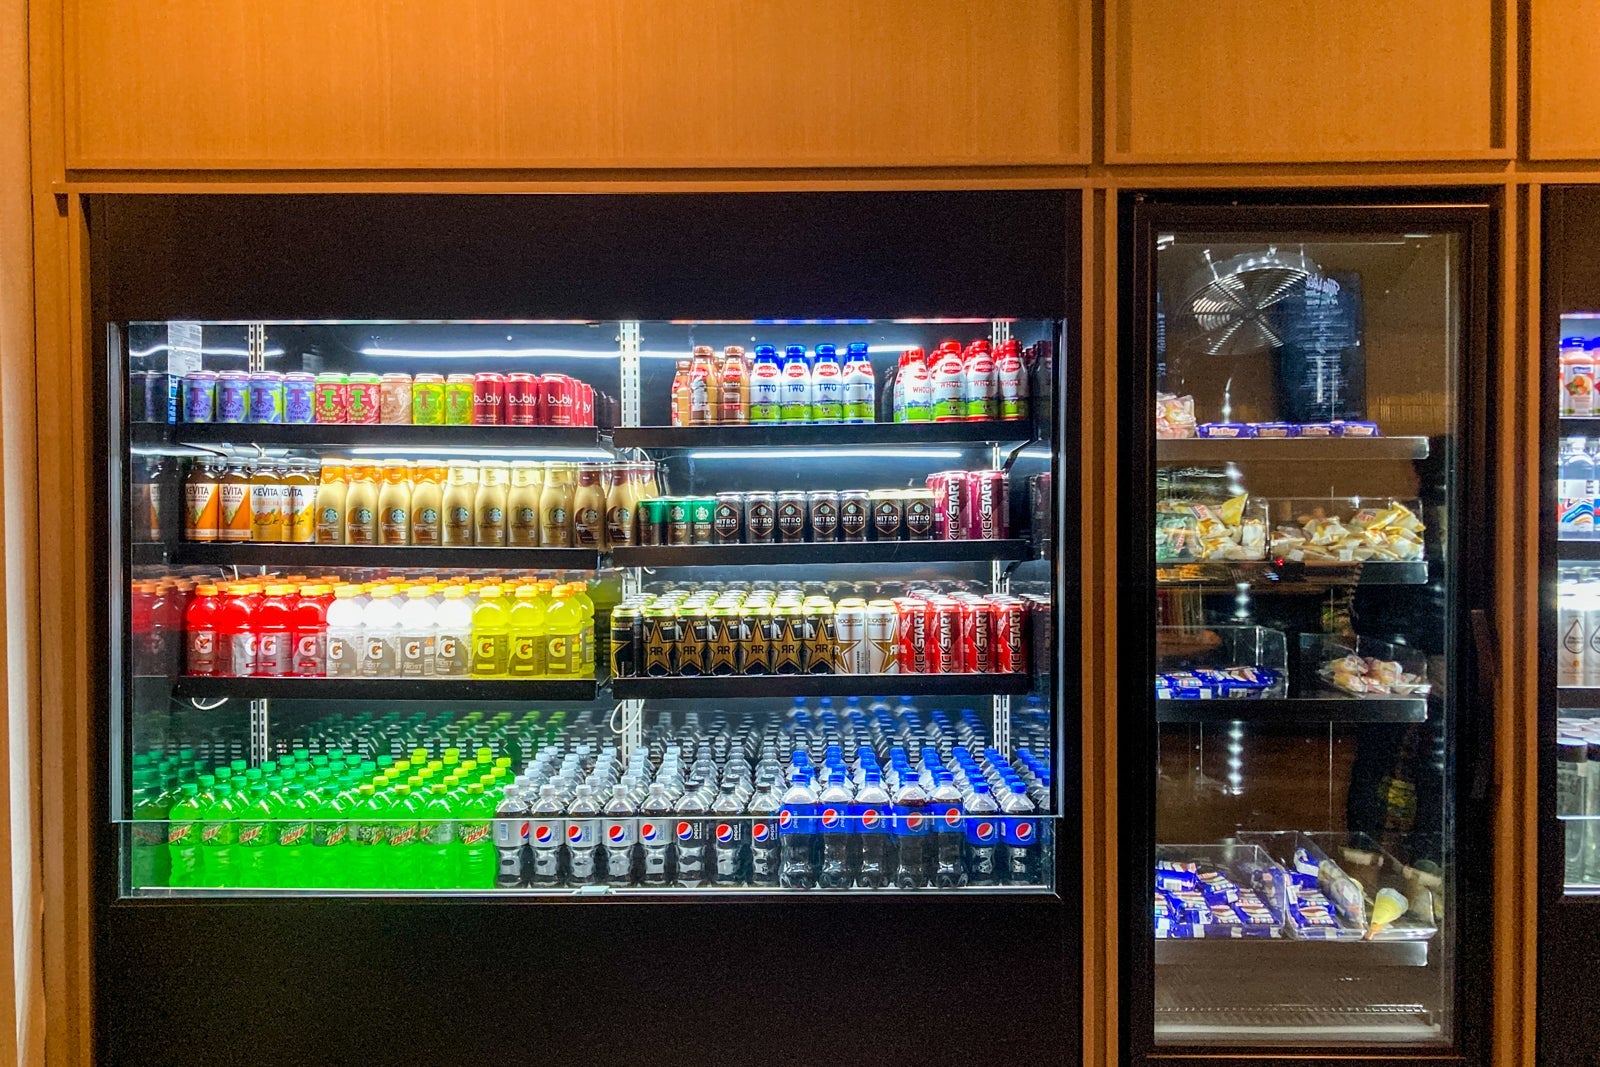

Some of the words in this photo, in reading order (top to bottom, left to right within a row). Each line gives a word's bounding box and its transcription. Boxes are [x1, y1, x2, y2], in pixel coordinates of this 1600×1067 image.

[758, 384, 777, 393] TWO
[788, 384, 805, 393] TWO
[819, 383, 837, 392] TWO
[473, 393, 501, 406] bubly
[509, 393, 537, 406] bubly
[222, 486, 243, 496] EVITA
[253, 487, 278, 497] KEVITA
[780, 517, 801, 525] NITRO
[260, 636, 276, 656] G
[299, 636, 316, 656] G
[329, 641, 342, 660] G
[368, 641, 382, 660] G
[405, 641, 420, 659] G
[440, 639, 455, 658] G
[477, 638, 494, 658] G
[515, 639, 532, 659] G
[549, 638, 566, 657] G
